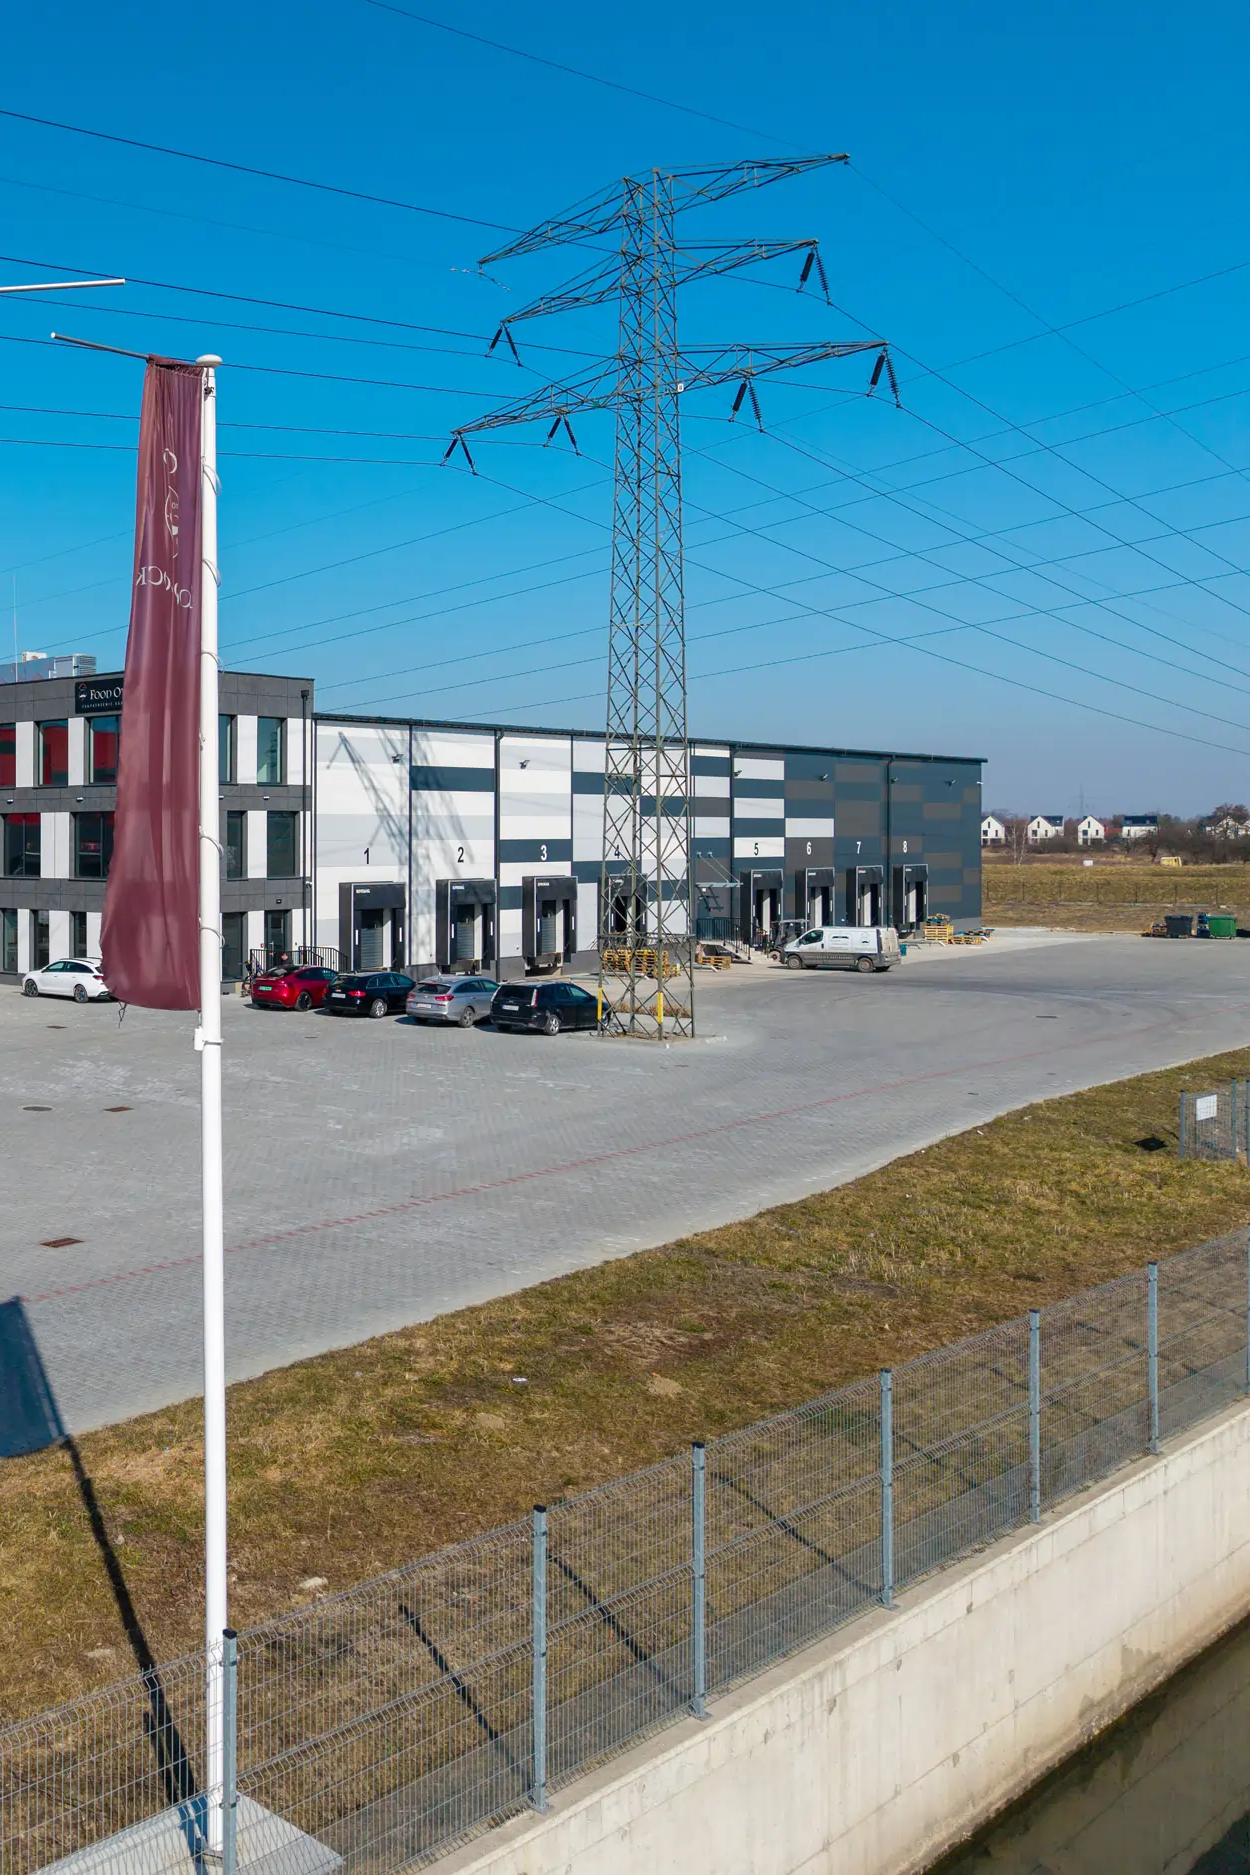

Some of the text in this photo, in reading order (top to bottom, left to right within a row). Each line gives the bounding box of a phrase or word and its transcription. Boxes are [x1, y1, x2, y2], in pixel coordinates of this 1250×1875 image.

[90, 689, 113, 700] FOOD
[540, 844, 548, 861] 3
[754, 842, 759, 856] 5
[806, 841, 812, 855] 6
[856, 841, 862, 854] 7
[903, 840, 908, 853] 8
[363, 847, 370, 864] 1
[457, 847, 465, 863] 2
